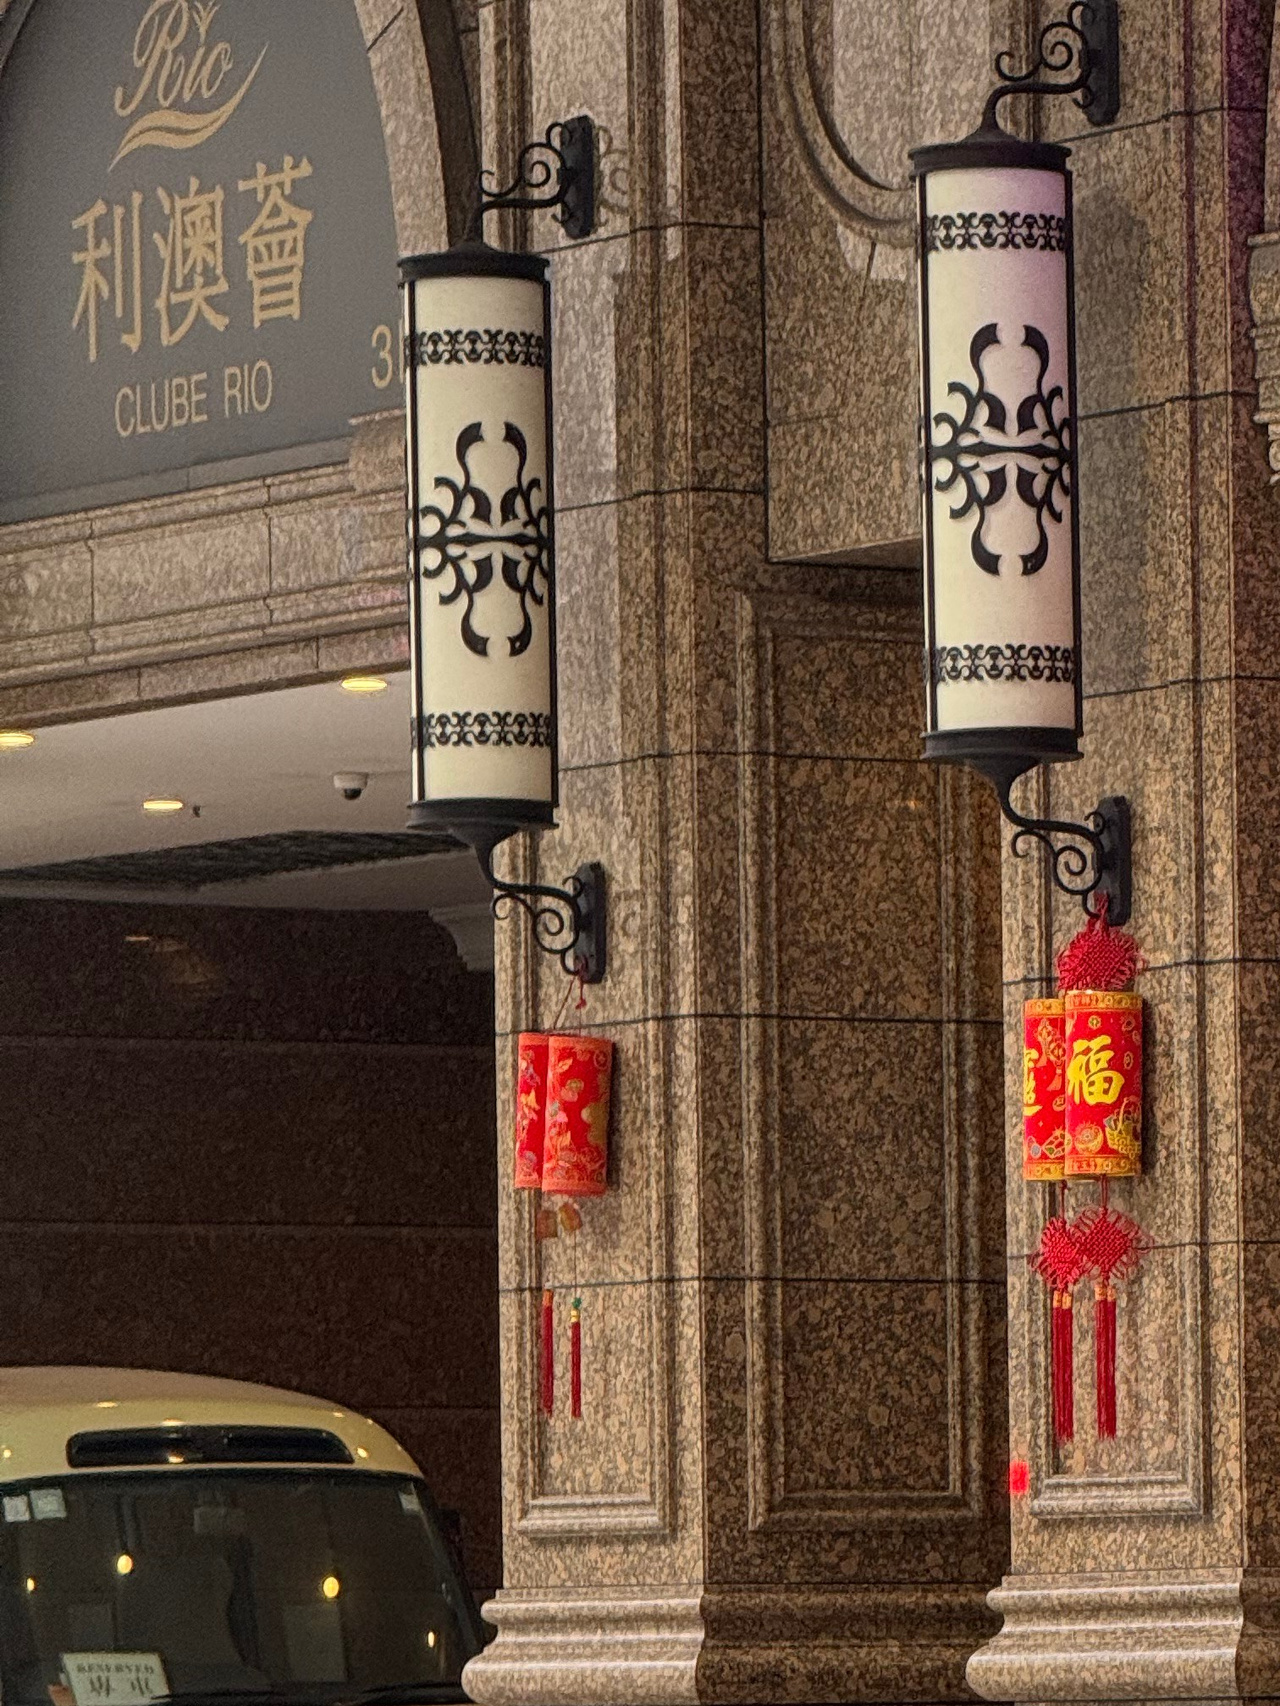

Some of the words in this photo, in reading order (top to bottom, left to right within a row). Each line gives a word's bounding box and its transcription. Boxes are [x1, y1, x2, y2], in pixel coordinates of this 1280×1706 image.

[114, 0, 233, 117] Rio
[71, 154, 314, 363] 利澳薈
[115, 372, 208, 437] CLUBE
[223, 359, 273, 418] RIO
[1067, 1034, 1125, 1106] 福
